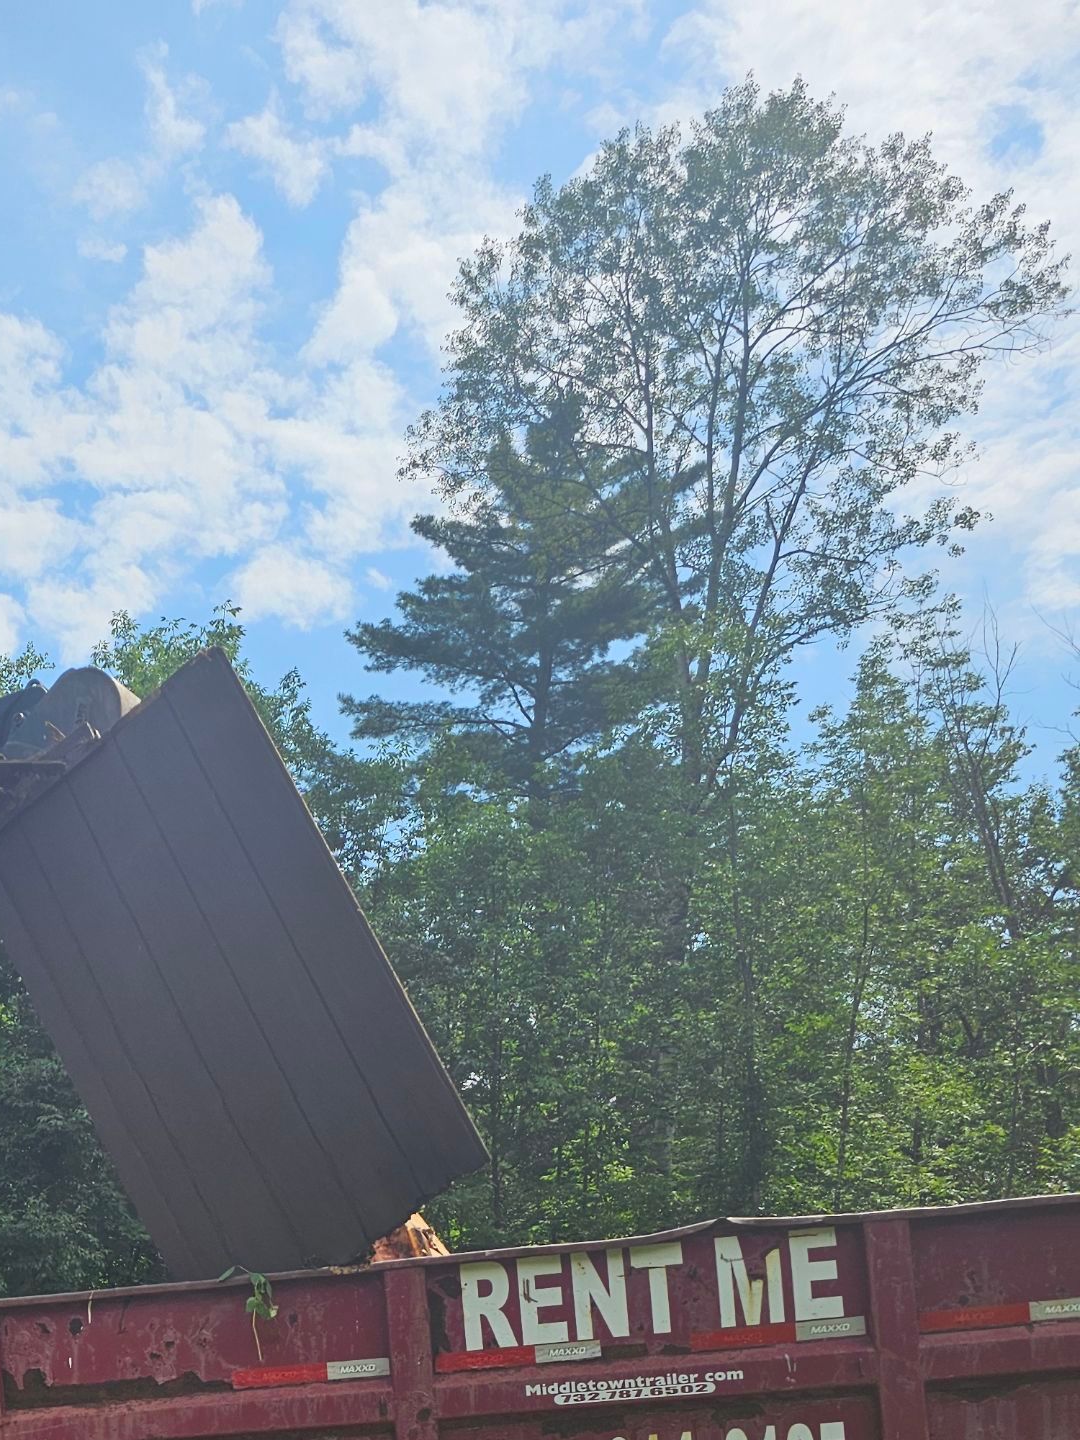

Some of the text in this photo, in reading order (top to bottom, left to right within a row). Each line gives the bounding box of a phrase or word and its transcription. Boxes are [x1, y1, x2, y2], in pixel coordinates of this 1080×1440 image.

[459, 1227, 845, 1352] RENT ME
[560, 1383, 709, 1403] 732.787.6502
